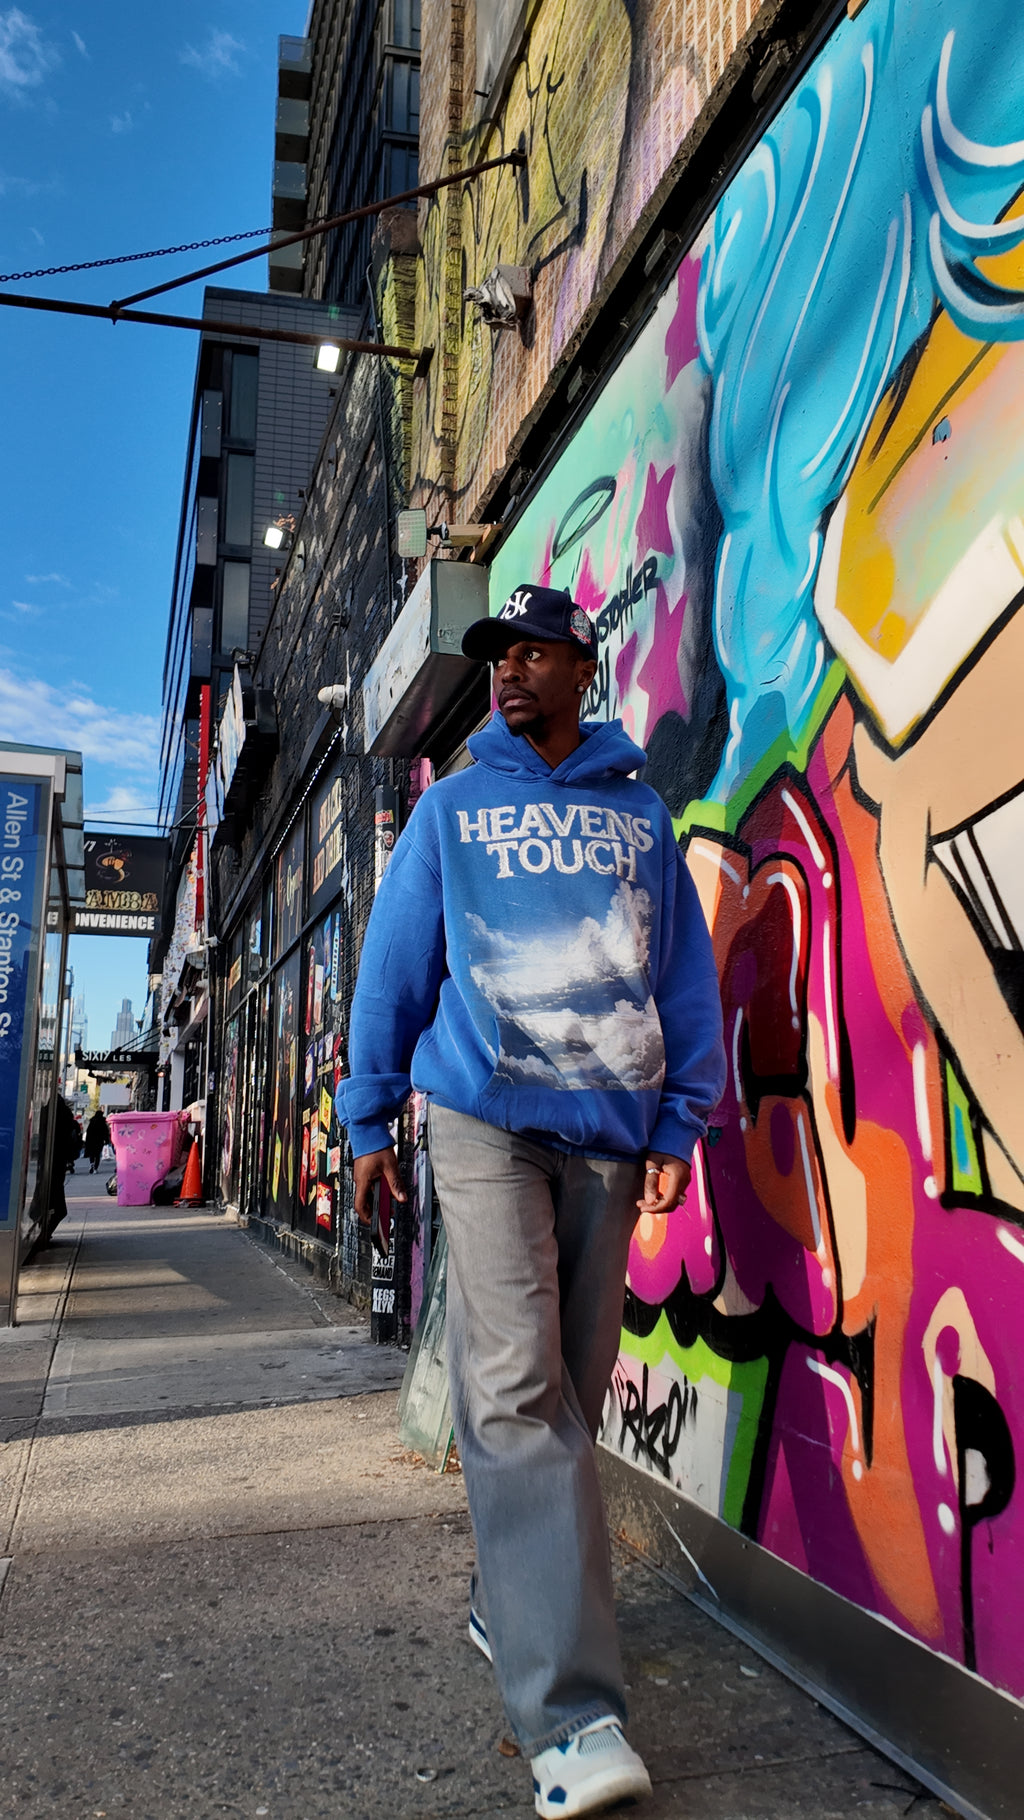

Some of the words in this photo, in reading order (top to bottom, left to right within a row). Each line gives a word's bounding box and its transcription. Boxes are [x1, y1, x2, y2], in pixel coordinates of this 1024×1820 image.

[4, 791, 28, 848] Allen
[456, 803, 654, 852] HEAVENS
[1, 856, 24, 881] St
[486, 838, 637, 882] TOUCH
[0, 888, 21, 904] &
[85, 889, 159, 912] AMBA
[75, 912, 155, 930] NVENIENCE
[82, 1050, 112, 1061] SIXTY
[373, 1288, 395, 1300] KEGS
